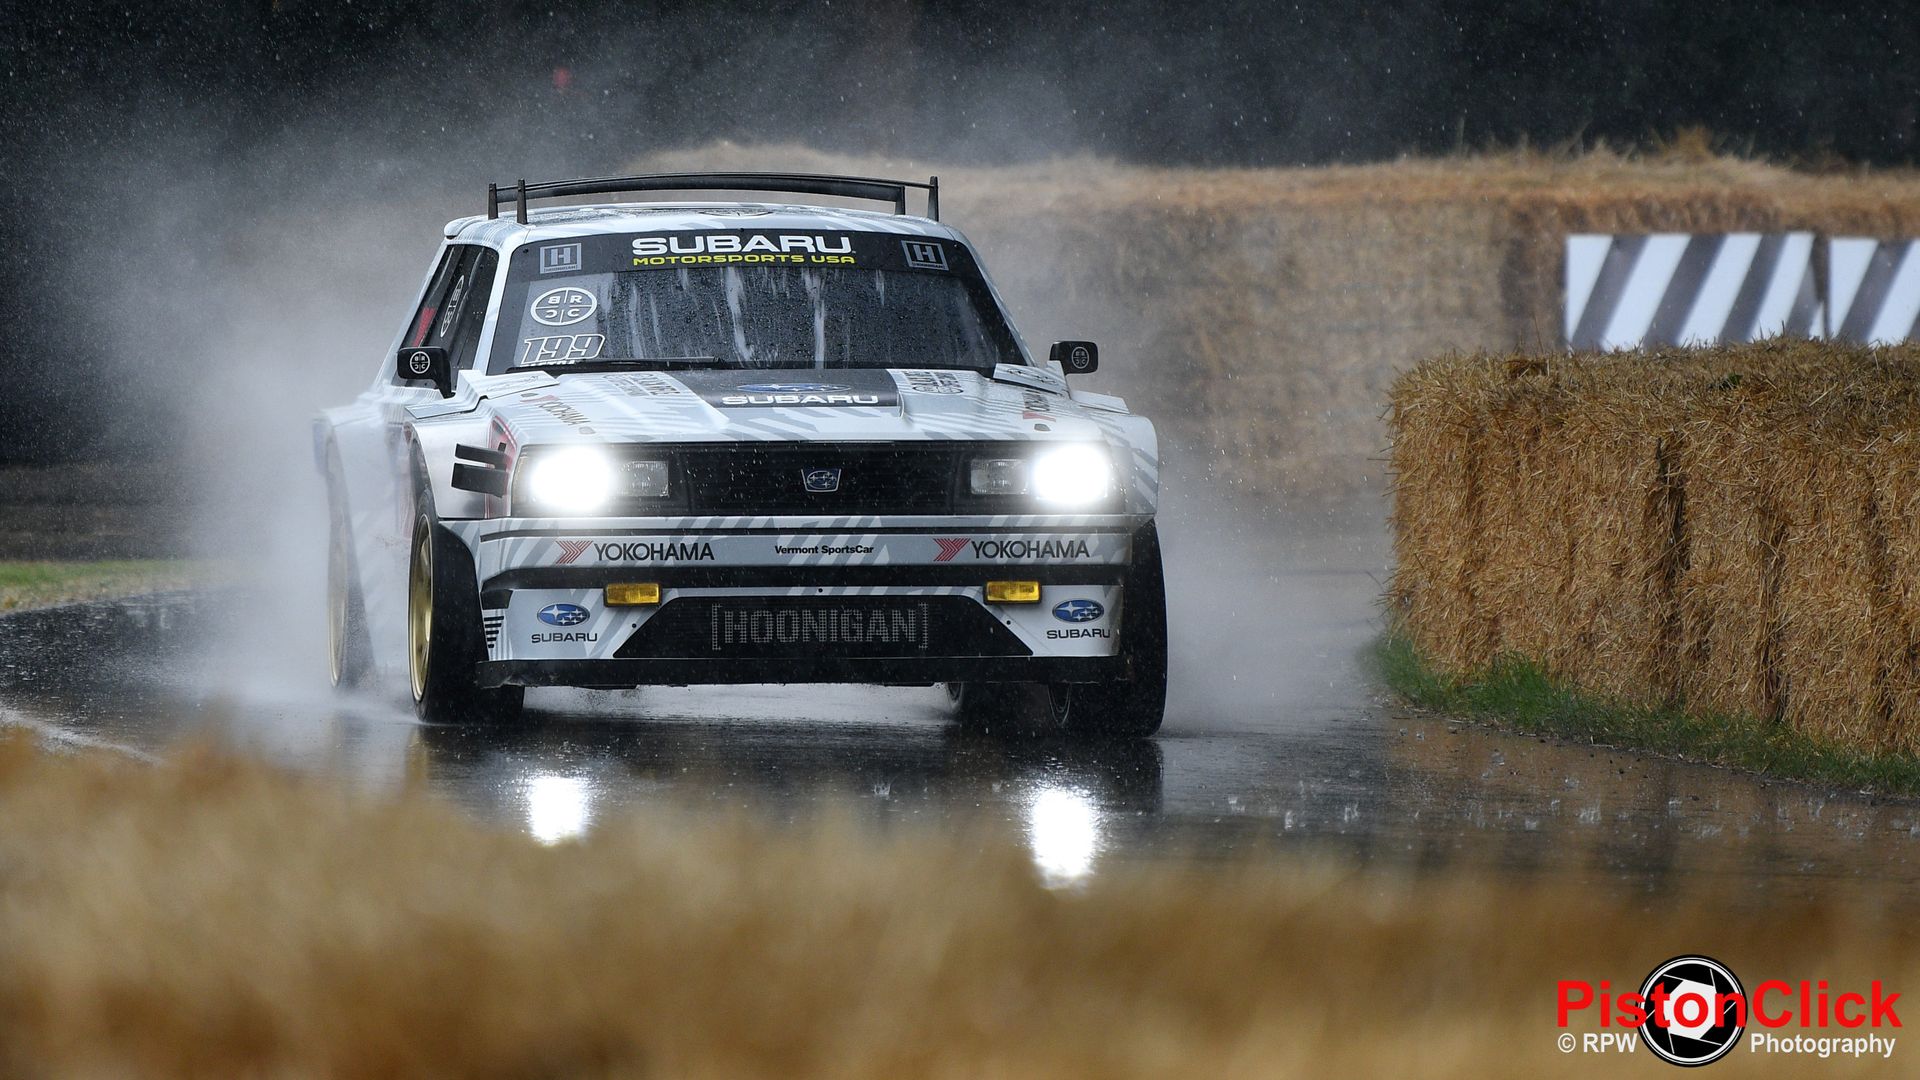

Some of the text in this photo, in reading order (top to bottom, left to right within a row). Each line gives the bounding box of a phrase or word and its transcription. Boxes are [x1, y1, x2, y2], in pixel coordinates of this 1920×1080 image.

[632, 235, 851, 255] SUBARU
[913, 244, 937, 262] H
[550, 247, 571, 266] H
[633, 254, 855, 266] MOTORSPORTS USA
[521, 334, 606, 365] 199
[722, 394, 879, 405] SUBARU
[594, 542, 715, 561] YOKOHAMA
[774, 545, 875, 555] Vermont SportsCar
[971, 540, 1090, 559] YOKOHAMA
[711, 602, 929, 651] [HOONIGAN]
[1046, 628, 1111, 640] SUBARU
[531, 632, 598, 643] SUBARU
